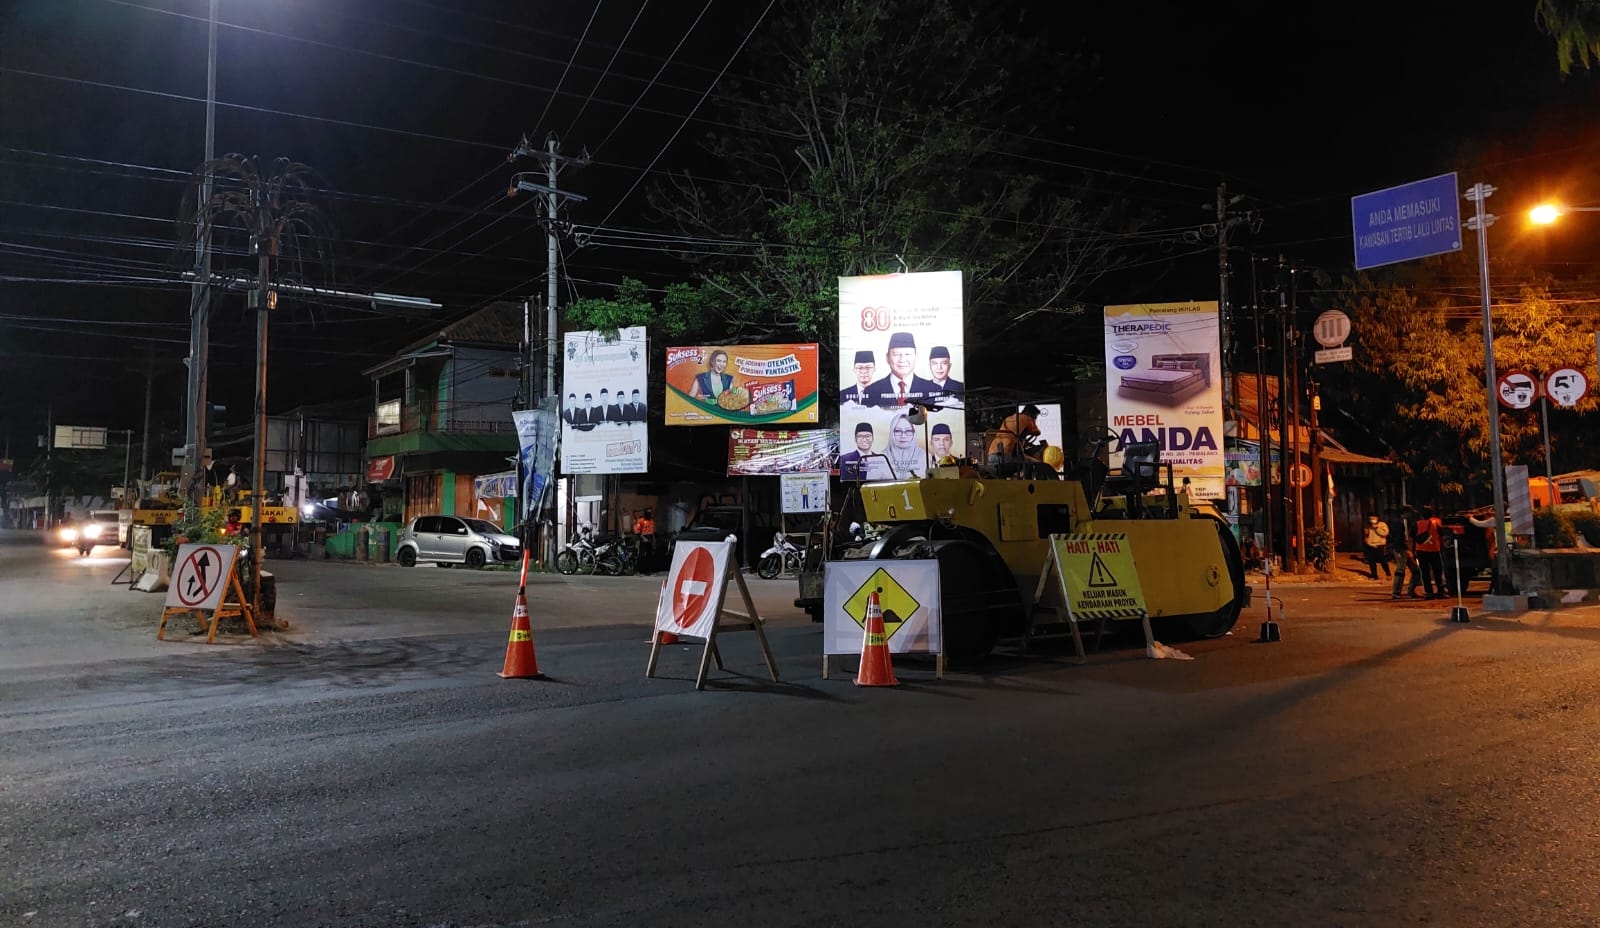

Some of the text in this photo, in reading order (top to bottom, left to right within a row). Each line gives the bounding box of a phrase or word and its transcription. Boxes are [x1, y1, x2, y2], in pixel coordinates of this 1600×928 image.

[1369, 197, 1440, 226] ANDA MEMASUKI
[1359, 216, 1454, 249] KAWASAN TERTIB LALU LINTAS
[861, 306, 891, 332] 80
[1112, 324, 1172, 333] THERAPEDIC
[768, 356, 795, 367] OTENTIK
[765, 363, 799, 375] FANTASTIK
[1113, 415, 1164, 426] MEBEL
[1116, 427, 1217, 450] ANDA
[1066, 541, 1089, 554] HATI
[1097, 541, 1120, 554] HATI
[1082, 589, 1128, 599] KELUAR MASUK
[1077, 599, 1136, 609] KENDARAAN PROYEK
